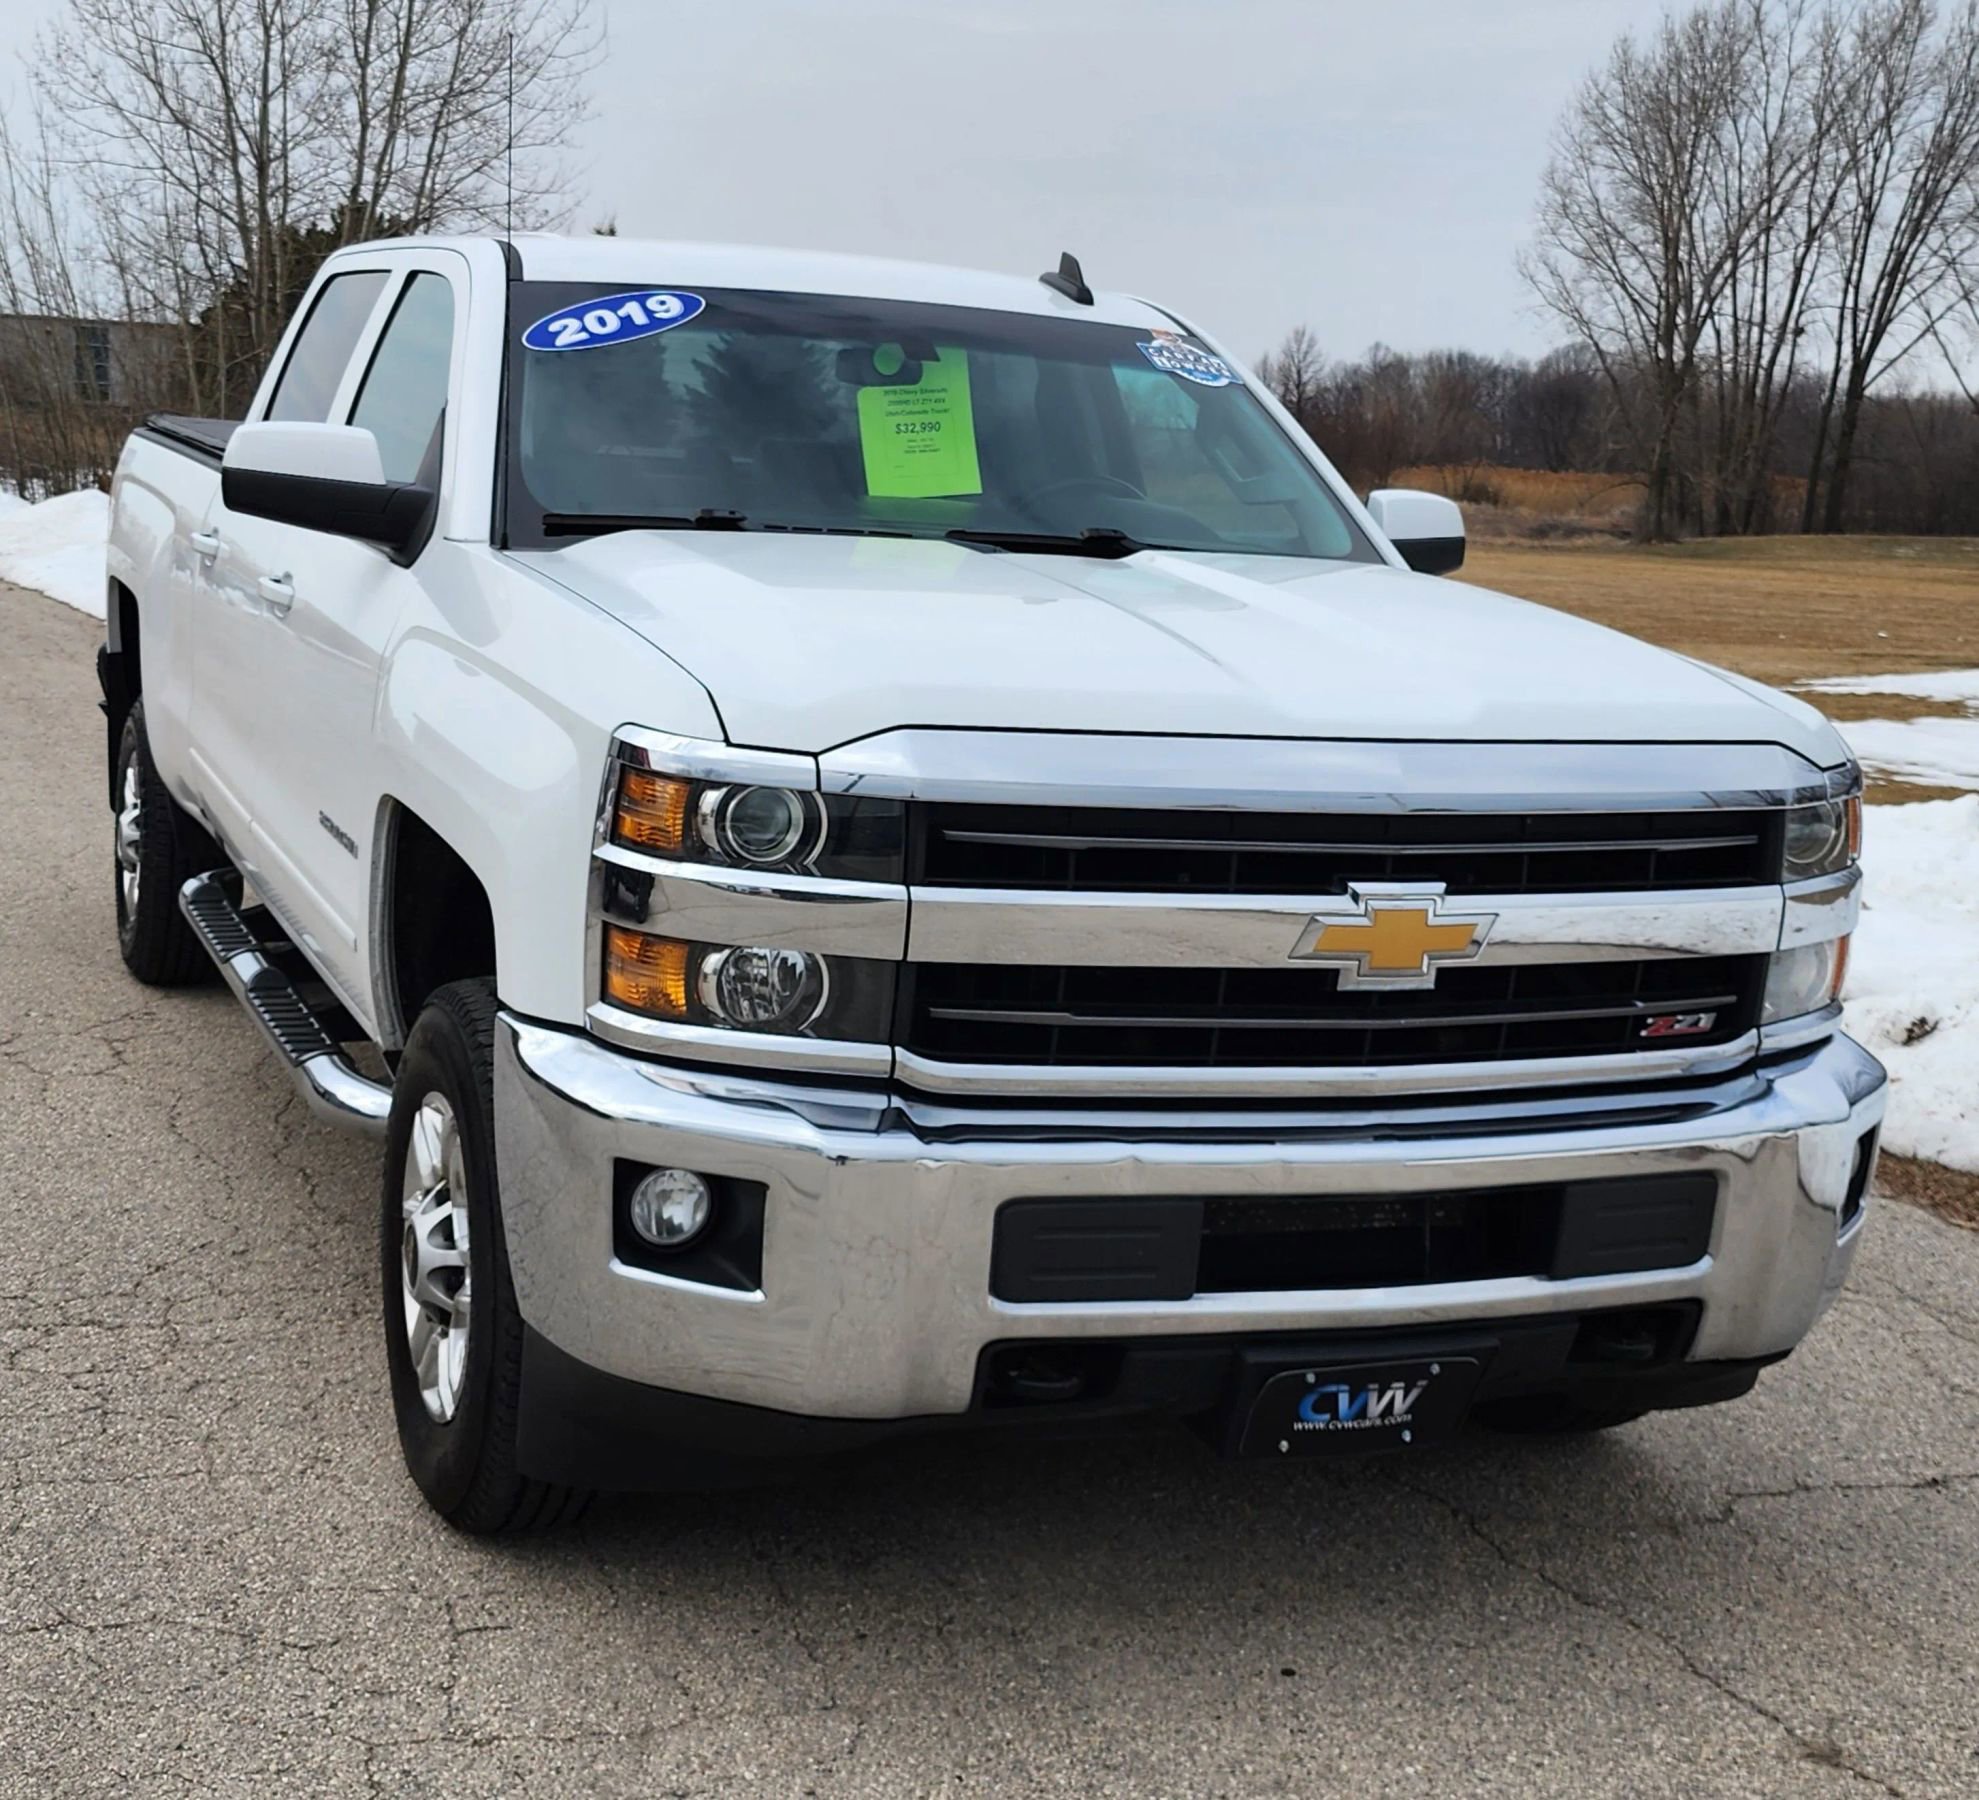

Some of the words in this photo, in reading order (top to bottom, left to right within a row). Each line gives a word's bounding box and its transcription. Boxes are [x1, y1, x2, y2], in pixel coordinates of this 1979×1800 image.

[548, 295, 684, 347] 2019
[895, 420, 942, 435] $32,990
[1640, 1012, 1717, 1037] Z71
